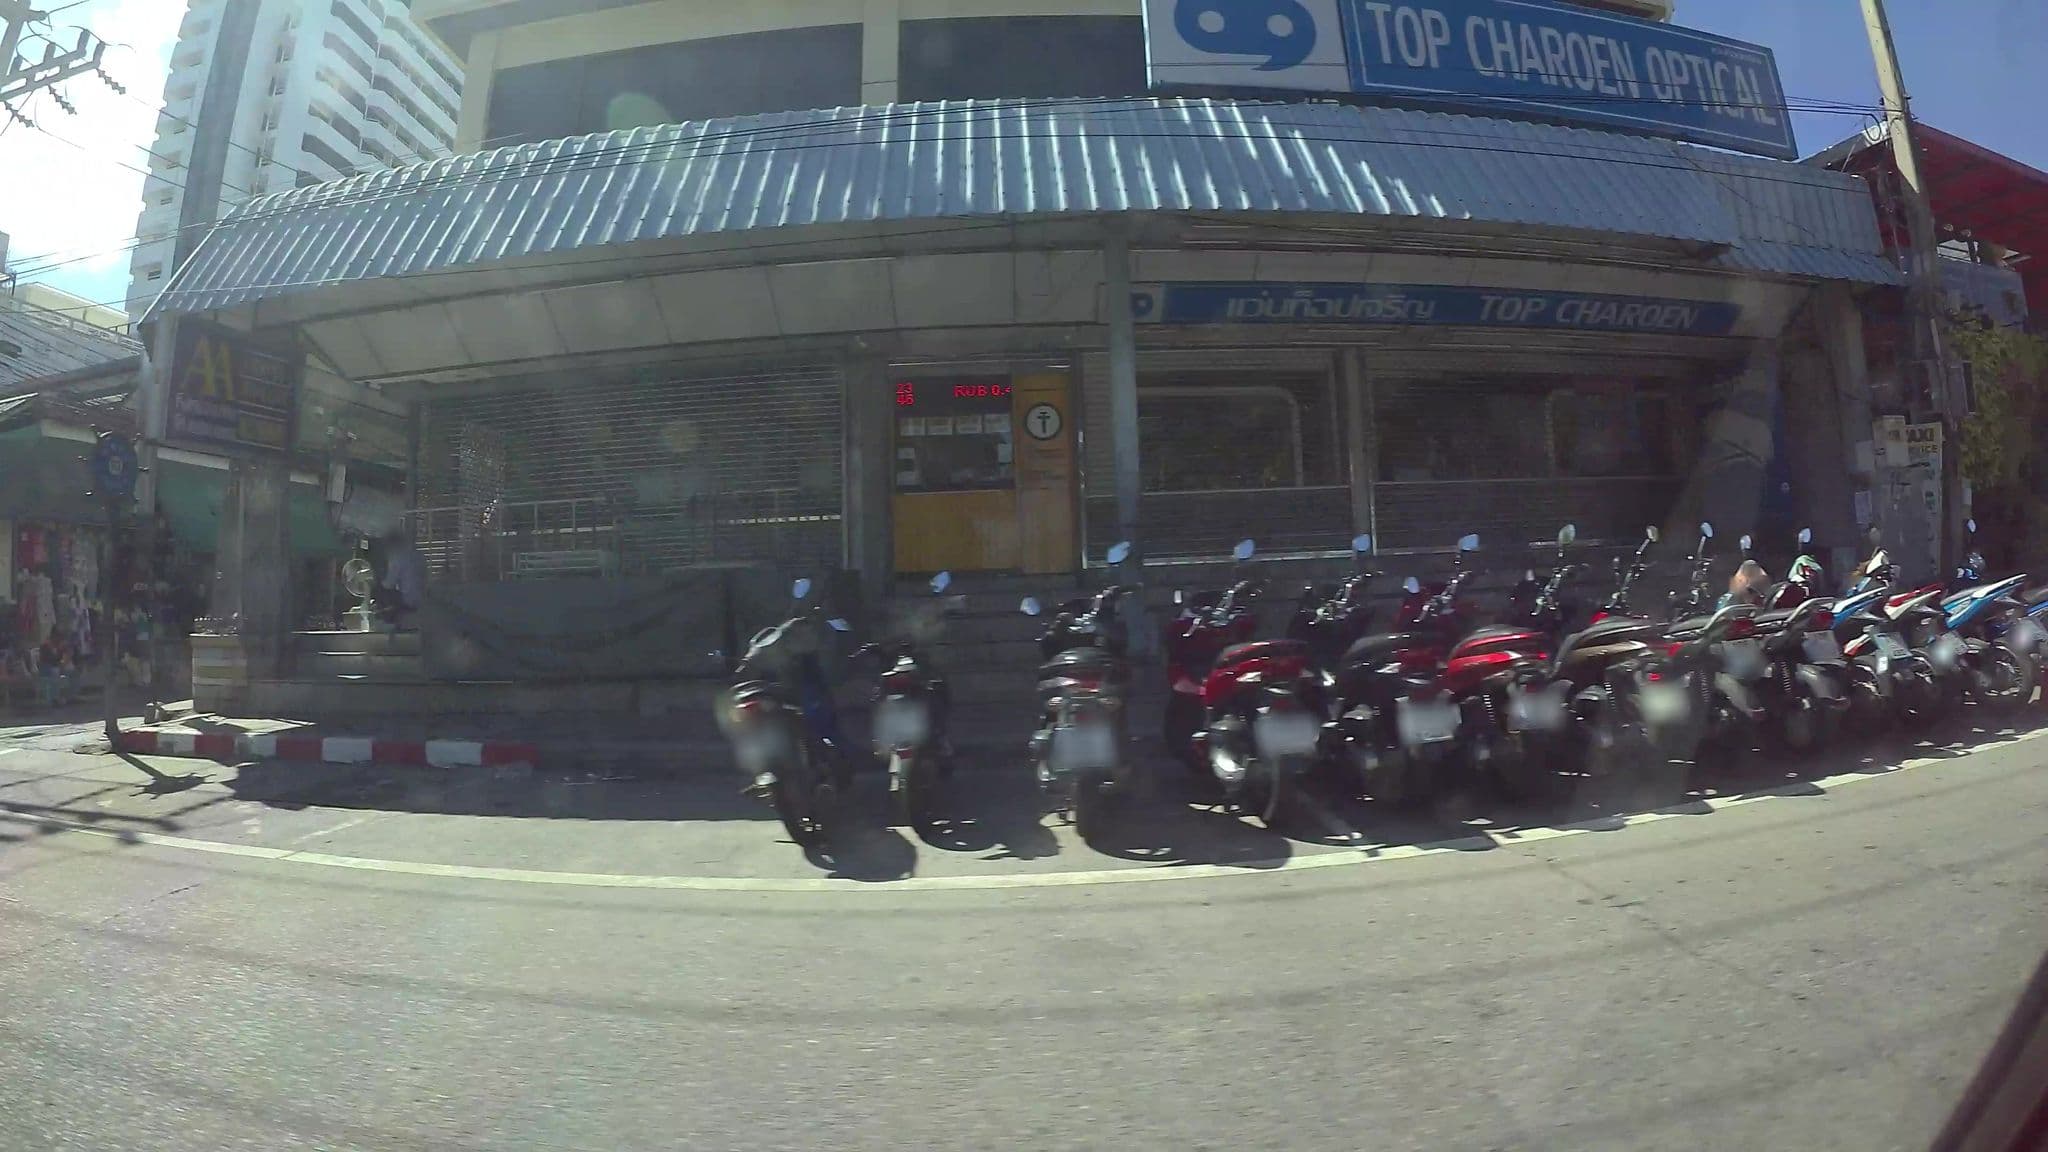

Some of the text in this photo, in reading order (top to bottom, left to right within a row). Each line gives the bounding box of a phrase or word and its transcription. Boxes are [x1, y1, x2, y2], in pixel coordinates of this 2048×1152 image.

[1365, 2, 1777, 126] TOP CHAROEN OPTICAL
[1480, 294, 1700, 330] TOP CHAROEN
[953, 384, 988, 397] RUB
